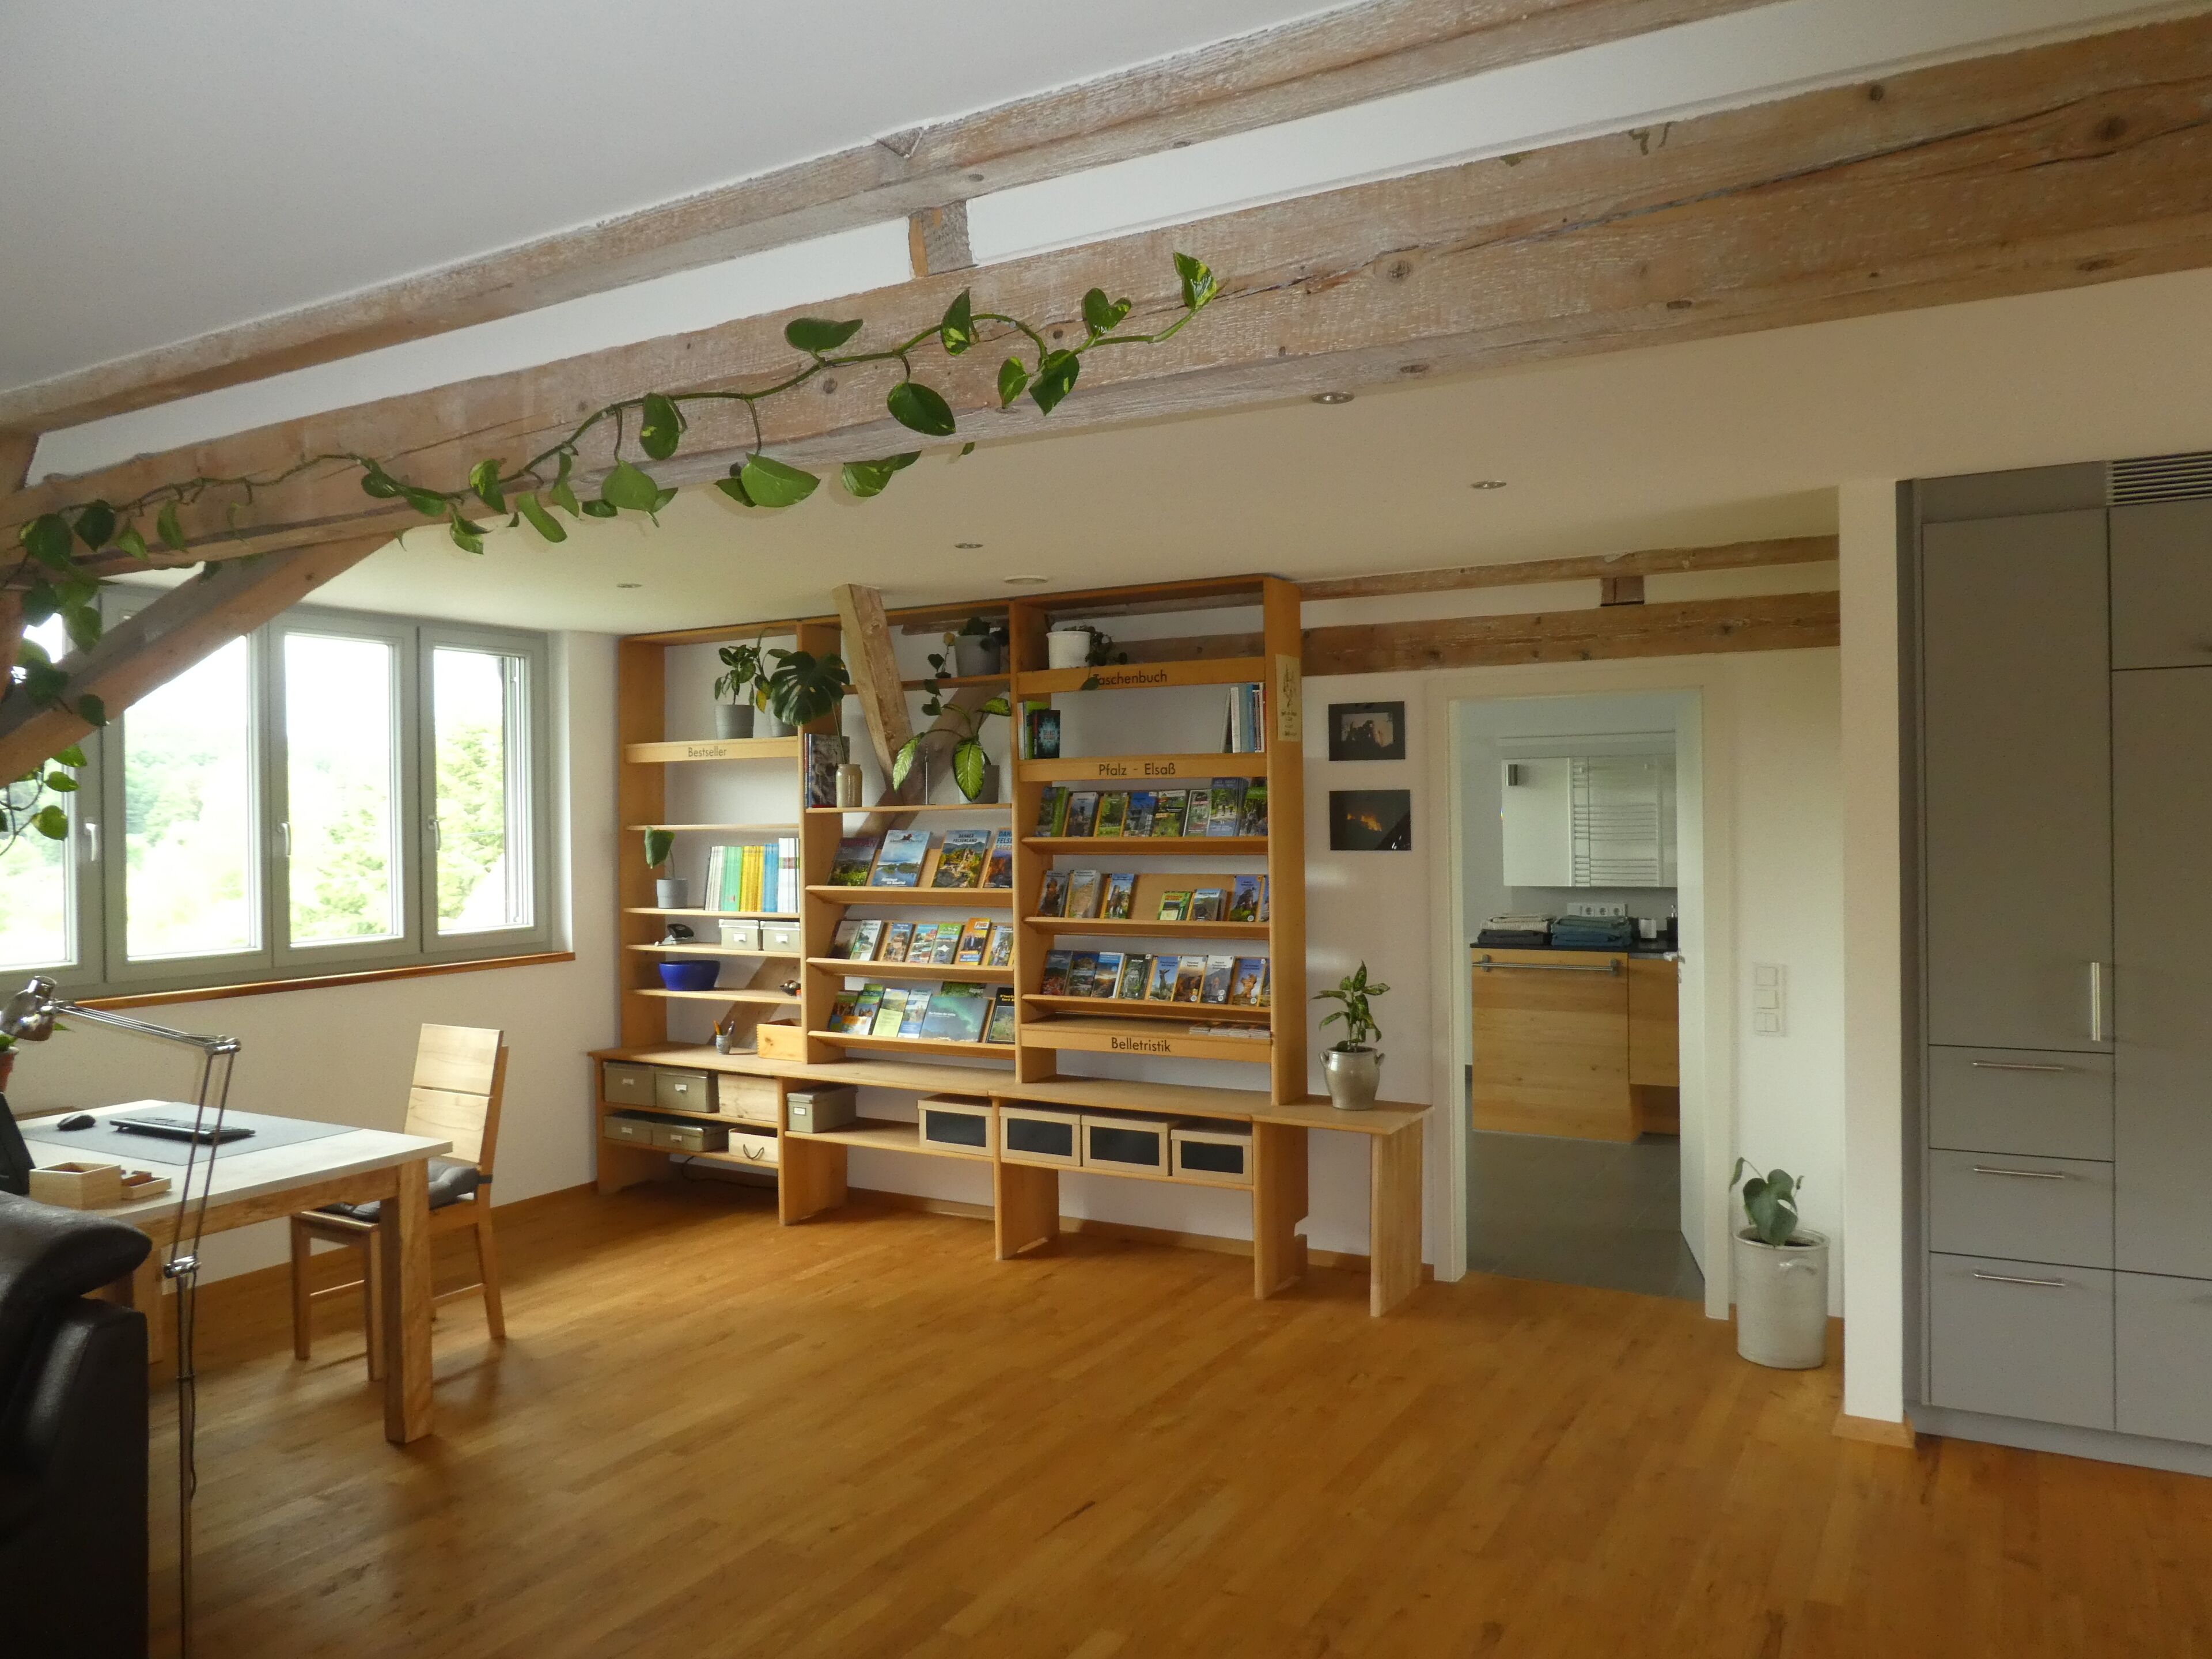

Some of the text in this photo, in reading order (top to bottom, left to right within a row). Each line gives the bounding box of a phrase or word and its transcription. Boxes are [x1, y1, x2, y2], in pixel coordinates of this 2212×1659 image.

[688, 745, 727, 757] Bestseller
[1099, 763, 1127, 776] Pfalz
[1144, 762, 1176, 775] Elsaß
[1111, 1037, 1171, 1053] Belletristik
